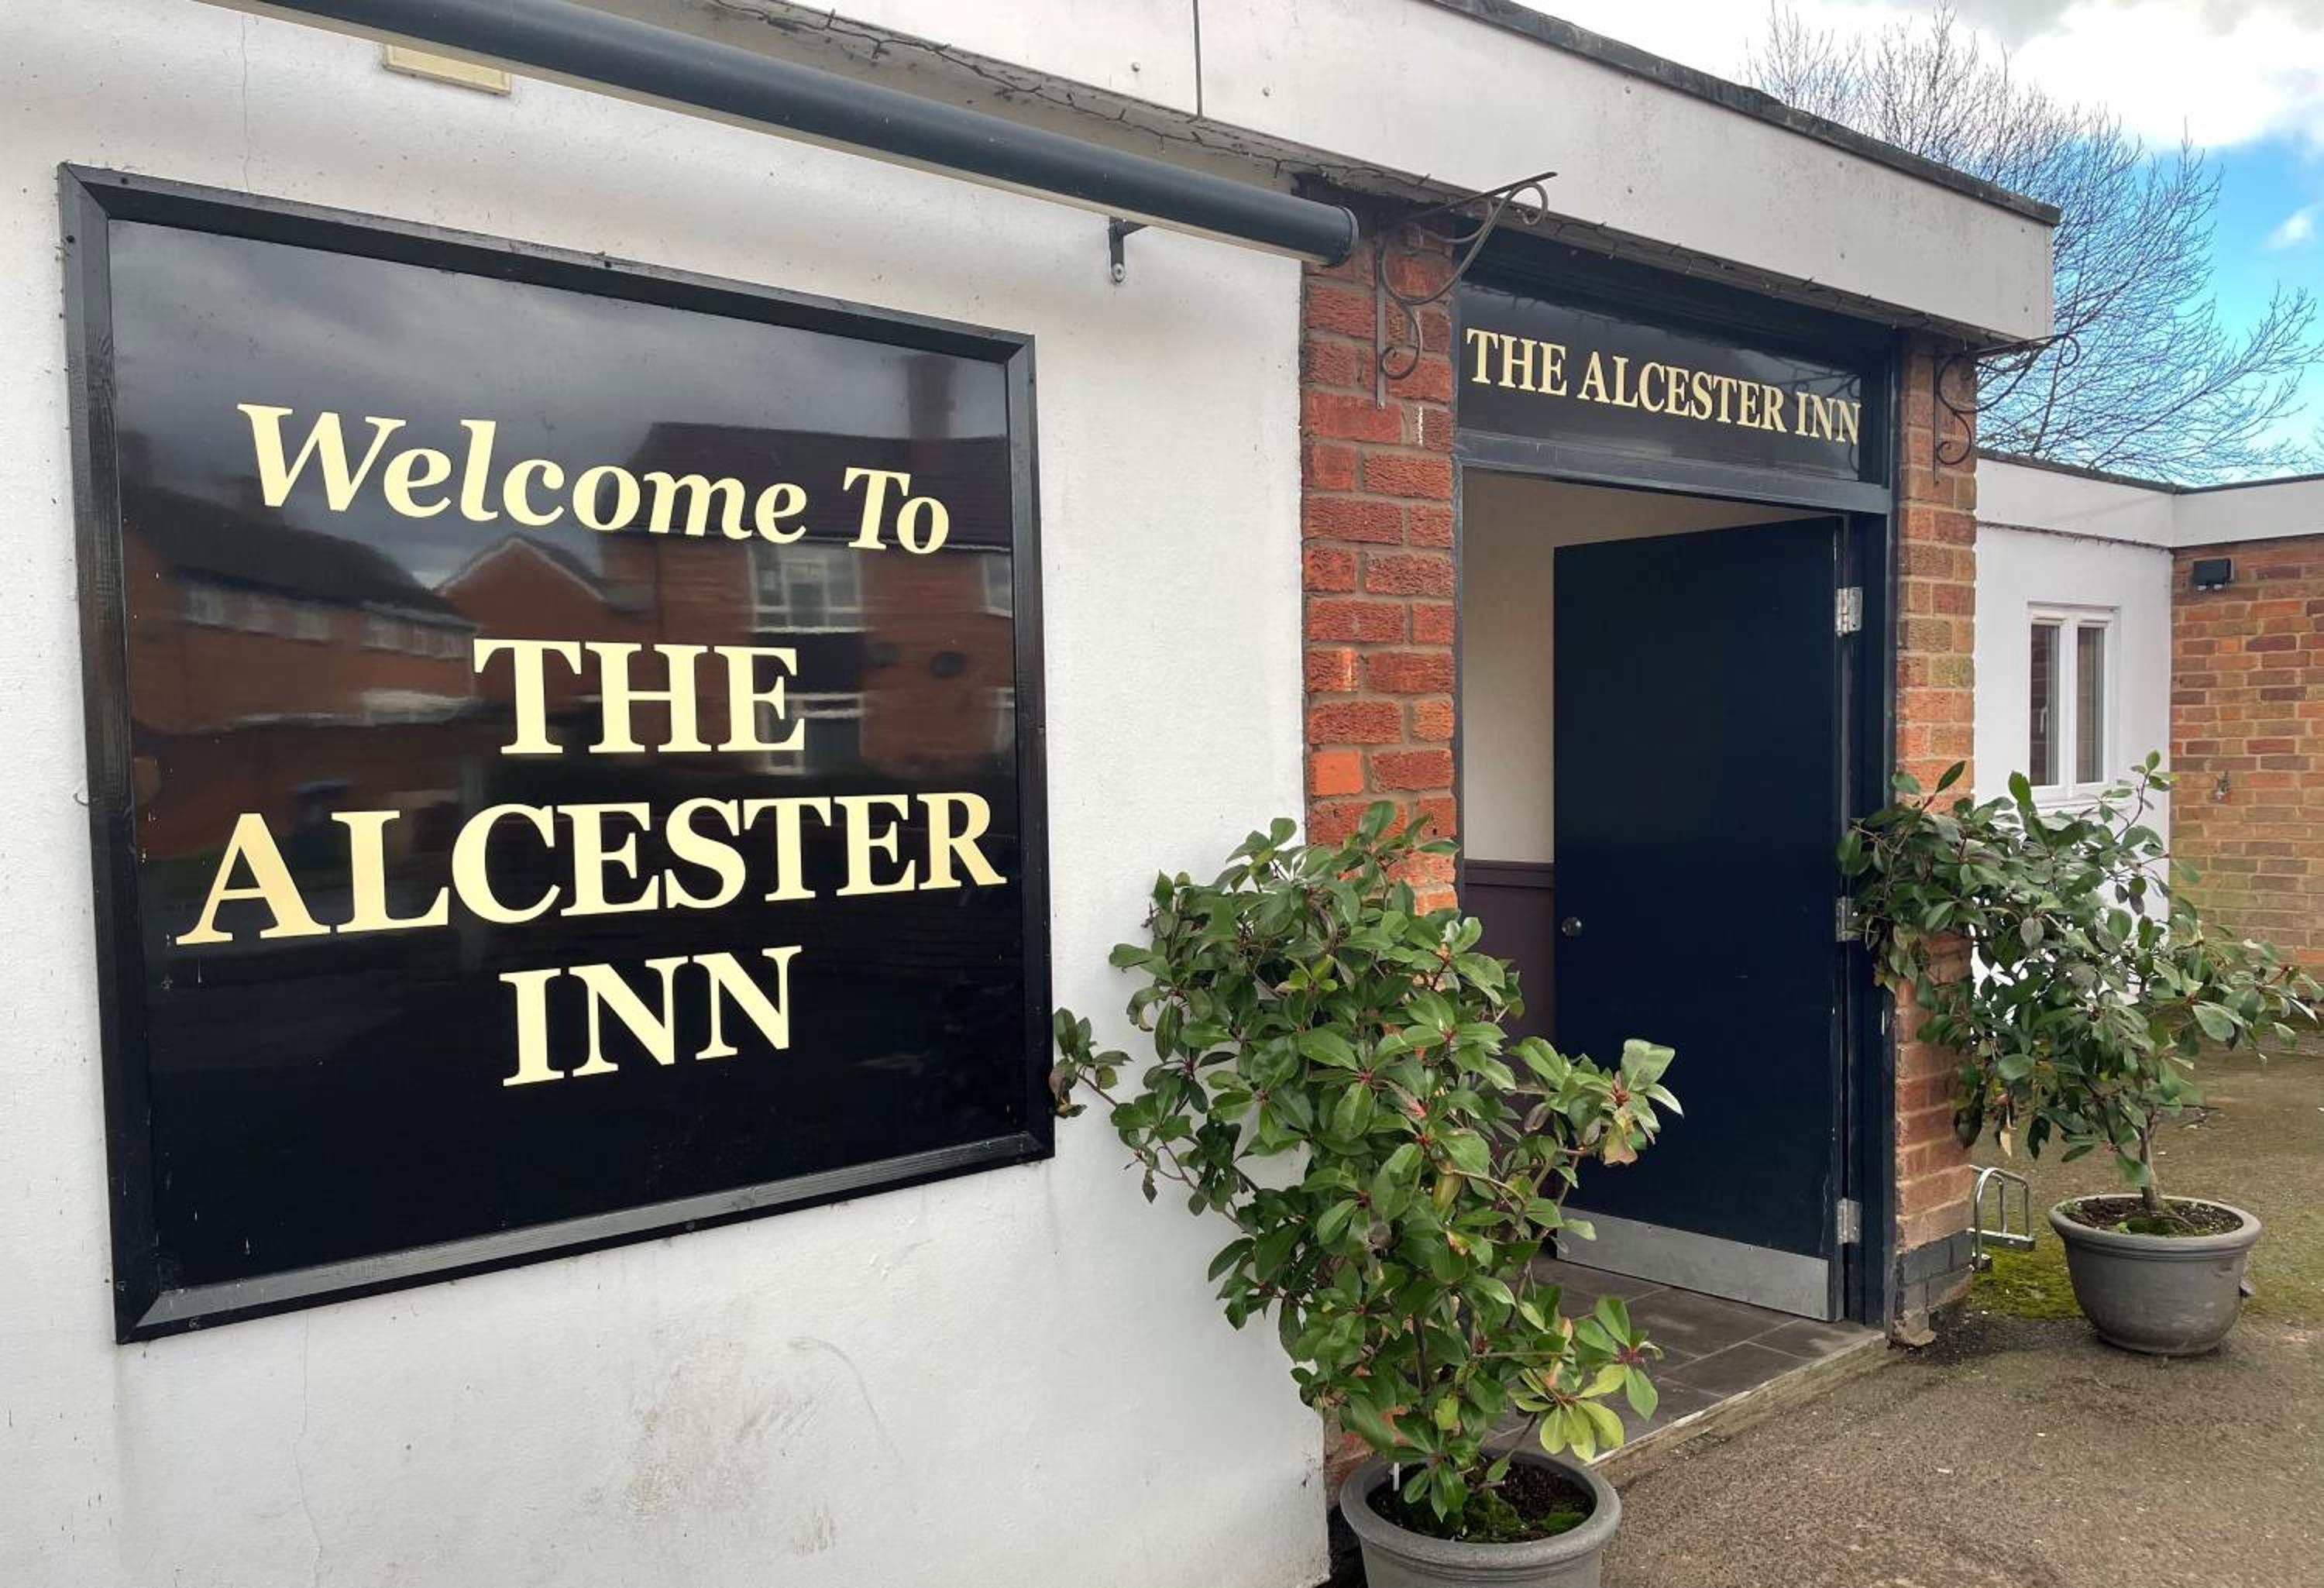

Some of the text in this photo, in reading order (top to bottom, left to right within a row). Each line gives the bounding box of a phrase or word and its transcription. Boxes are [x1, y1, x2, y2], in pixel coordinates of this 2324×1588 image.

[1466, 328, 1861, 445] THE ALCESTER INN
[237, 403, 951, 555] Welcome To
[473, 638, 806, 754] THE
[175, 792, 1007, 946] ALCESTER
[499, 945, 803, 1087] INN
